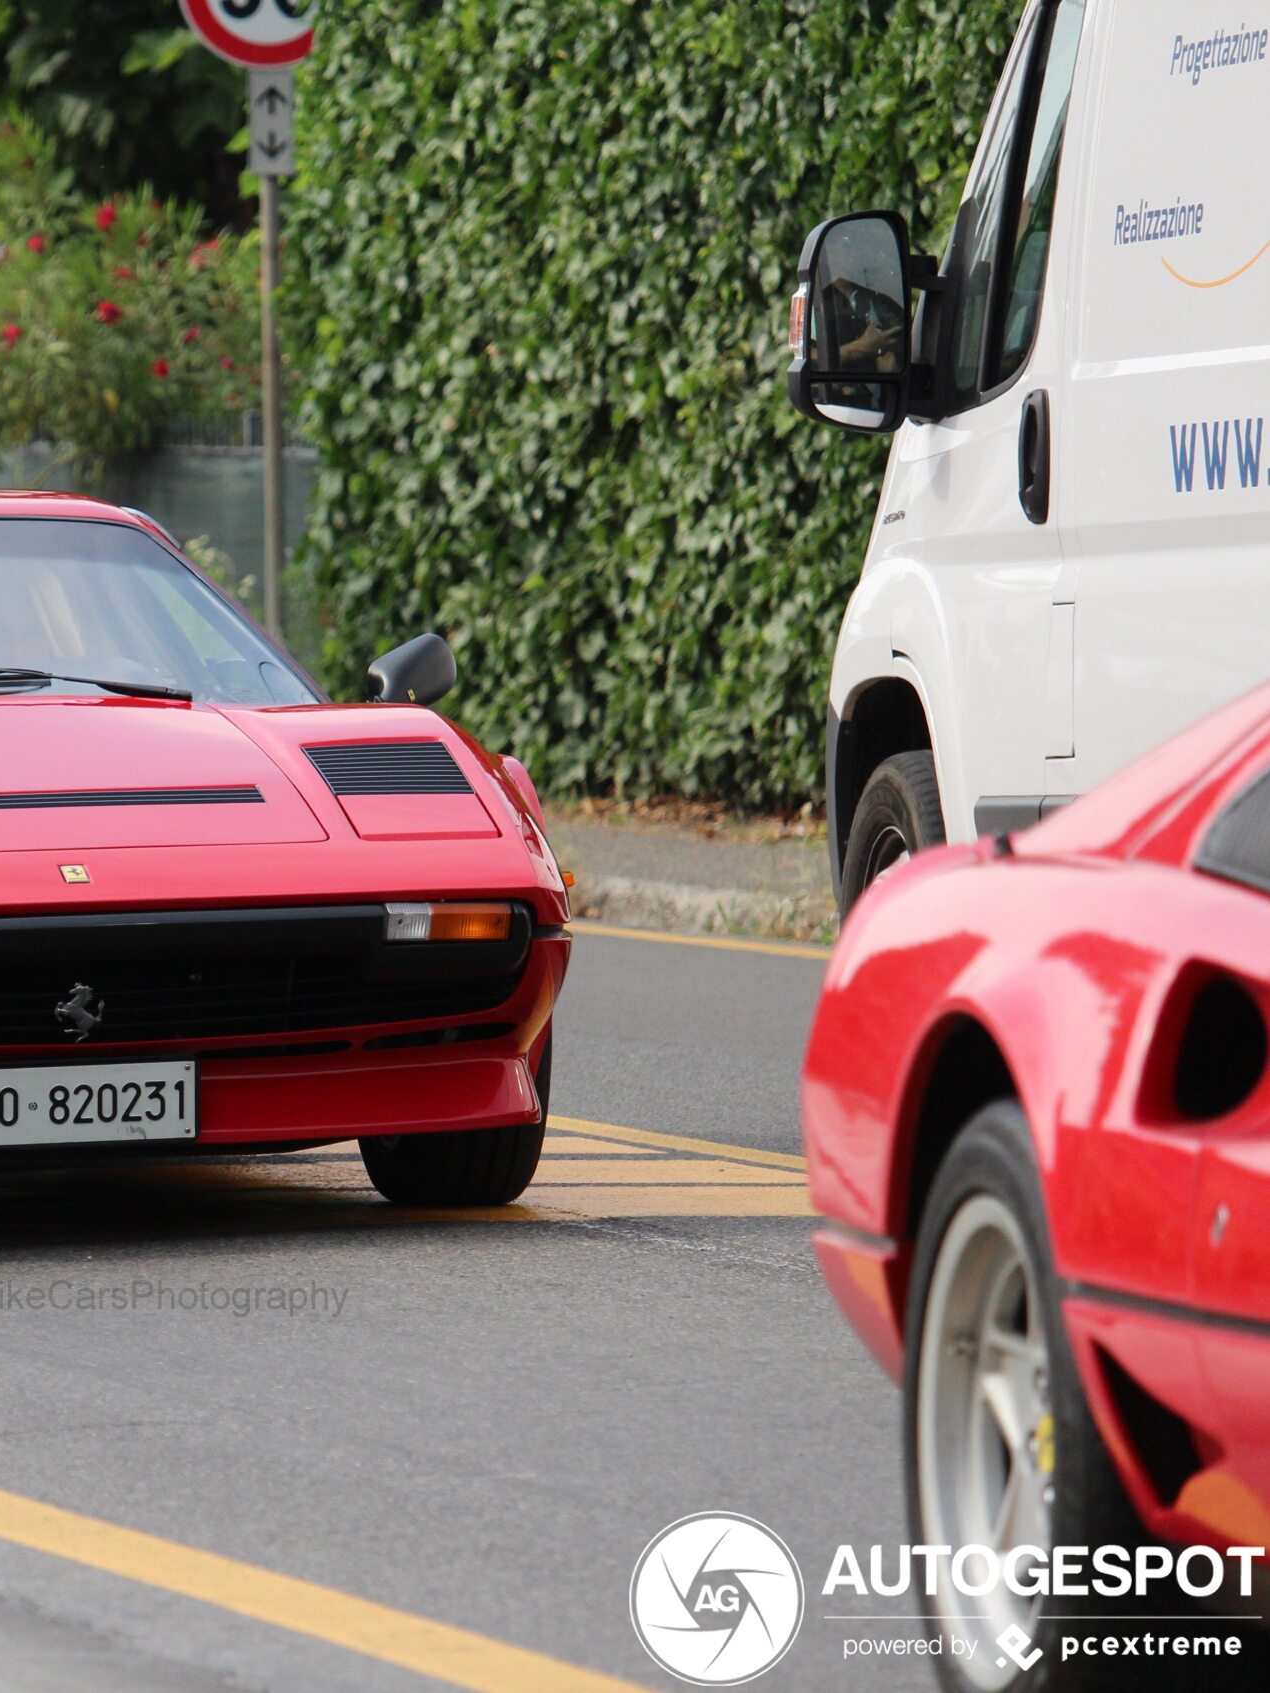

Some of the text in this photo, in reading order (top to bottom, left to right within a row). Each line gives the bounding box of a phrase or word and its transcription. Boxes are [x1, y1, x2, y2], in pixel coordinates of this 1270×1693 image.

[1170, 23, 1269, 85] Progettazione
[1114, 197, 1204, 245] Realizzazione
[49, 1080, 184, 1125] 820231
